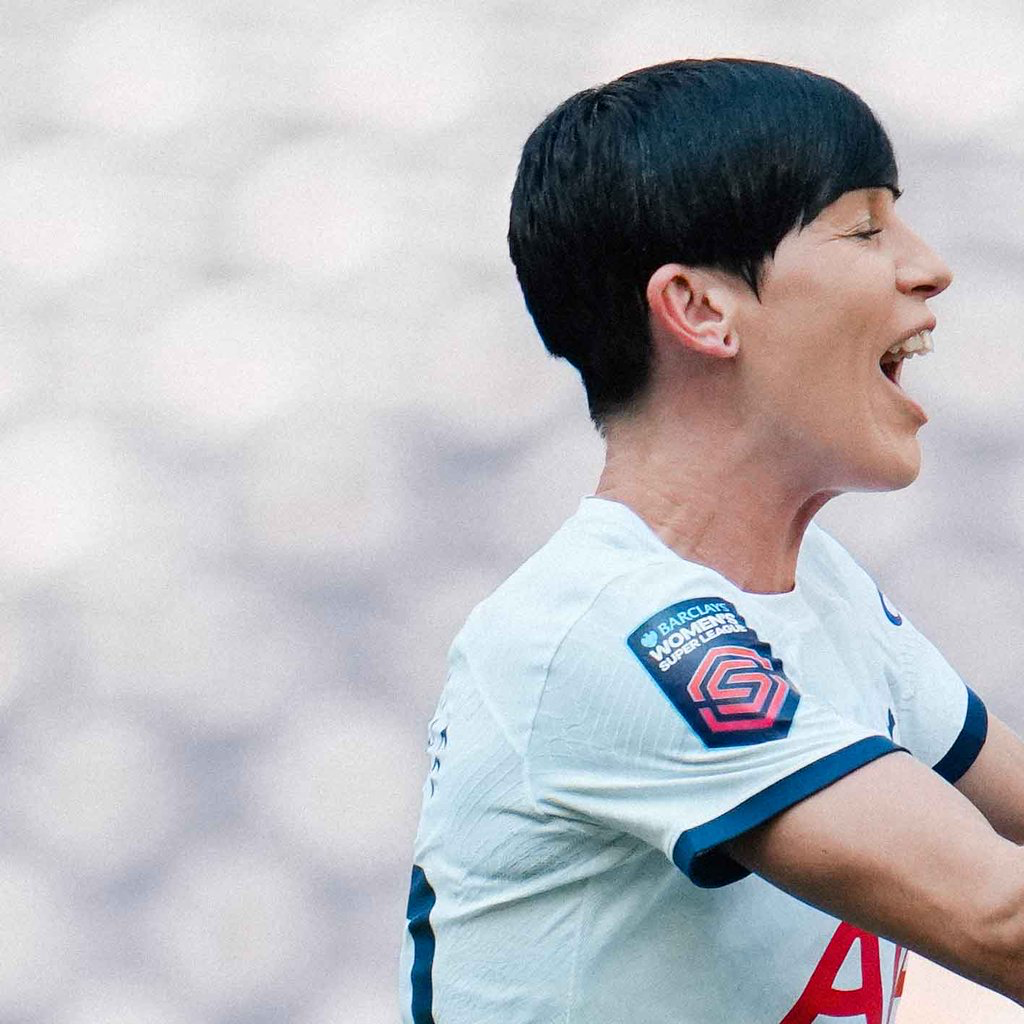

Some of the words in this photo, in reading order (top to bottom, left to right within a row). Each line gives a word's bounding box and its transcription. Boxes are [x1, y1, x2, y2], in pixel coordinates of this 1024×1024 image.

[649, 613, 738, 662] WOMEN'S
[658, 603, 730, 636] BARCLAYS
[659, 639, 701, 672] SUPER
[699, 623, 748, 644] LEAGUE
